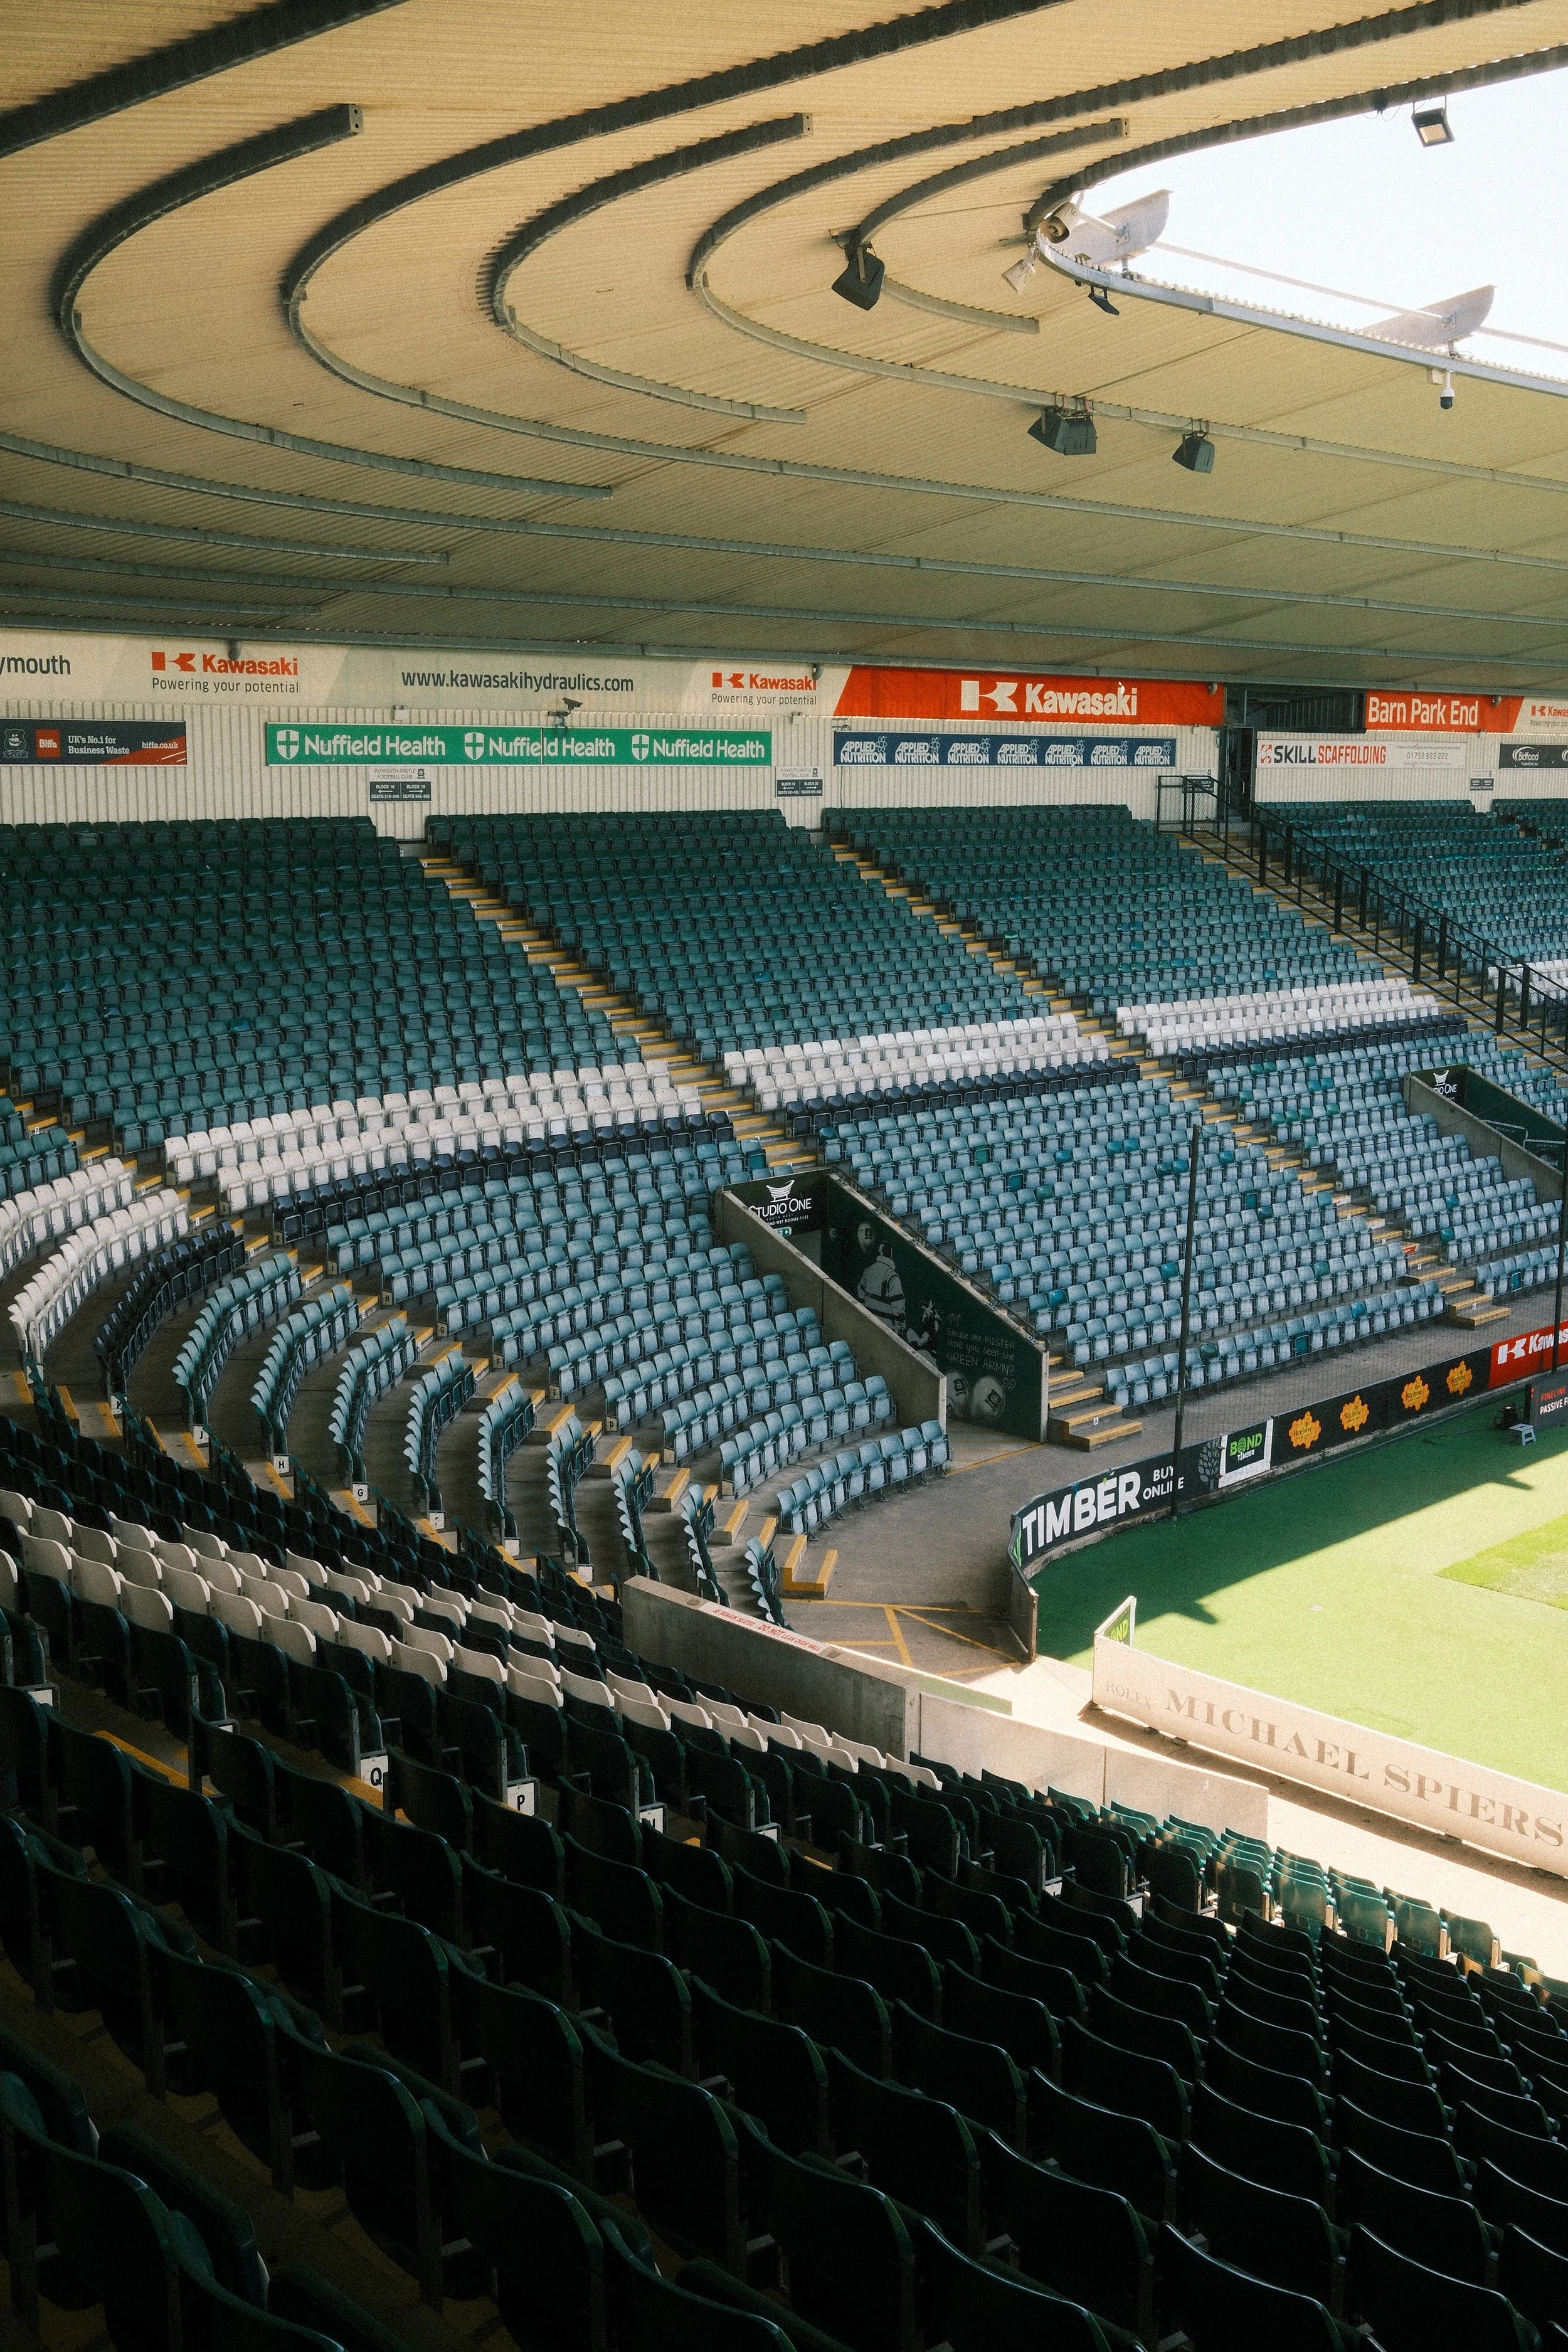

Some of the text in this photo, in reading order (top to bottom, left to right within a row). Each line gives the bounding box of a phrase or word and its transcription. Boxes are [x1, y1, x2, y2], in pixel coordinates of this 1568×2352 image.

[202, 654, 299, 675] Kawasaki
[152, 677, 299, 694] Powering your potential
[401, 669, 634, 693] www.kawasakihydraulics.com
[750, 674, 817, 691] Kawasaki
[712, 693, 817, 706] Powering your potential
[1025, 682, 1138, 716] Kawasaki
[1369, 697, 1478, 726] Barn Park End
[1530, 719, 1550, 728] Powering
[39, 738, 57, 748] Biffa
[68, 735, 116, 744] UK's No.1 for
[141, 741, 179, 750] biffa.co.uk
[304, 734, 446, 756] Nuffield Health
[68, 745, 130, 755] Business Waste
[489, 736, 615, 757] Nuffield Health
[653, 738, 765, 758] Nuffield Health
[841, 741, 876, 753] APPLIED
[896, 742, 930, 753] APPLIED
[948, 743, 980, 753] APPLIED
[998, 743, 1029, 754] APPLIED
[1046, 744, 1074, 755] APPLIED
[1091, 744, 1120, 755] APPLIED
[1135, 745, 1162, 755] APPLIED
[840, 752, 886, 763] NUTRITION
[895, 753, 940, 763] NUTRITION
[948, 753, 990, 764] NUTRITION
[997, 753, 1037, 765] NUTRITION
[1045, 754, 1084, 765] NUTRITION
[1091, 755, 1128, 765] NUTRITION
[1135, 755, 1170, 765] NUTRITION
[1274, 744, 1387, 765] SKILL SCAFFOLDING
[1518, 751, 1539, 761] Bidfood
[1444, 1084, 1458, 1094] ONE
[788, 1198, 812, 1212] ONE
[947, 1328, 969, 1340] Excuse
[985, 1336, 1015, 1350] MISTER
[947, 1338, 1015, 1361] Have you seen the
[946, 1352, 1015, 1376] GREEN ARMY?
[1540, 1385, 1566, 1401] FINELINE
[1540, 1398, 1563, 1416] PASSIVE
[199, 1431, 204, 1439] J
[1230, 1433, 1263, 1456] BOND
[1237, 1449, 1255, 1461] TIMBER
[1153, 1465, 1174, 1482] BUY
[721, 1611, 737, 1621] REMAIN
[738, 1617, 755, 1626] SEATED
[758, 1623, 768, 1631] DO
[769, 1627, 785, 1638] NOT
[795, 1638, 809, 1646] OVER
[808, 1643, 822, 1651] WALL
[1106, 1680, 1152, 1710] ROLEX
[1164, 1688, 1565, 1848] MICHAEL SPIERS
[369, 1767, 383, 1787] Q
[516, 1794, 526, 1809] P
